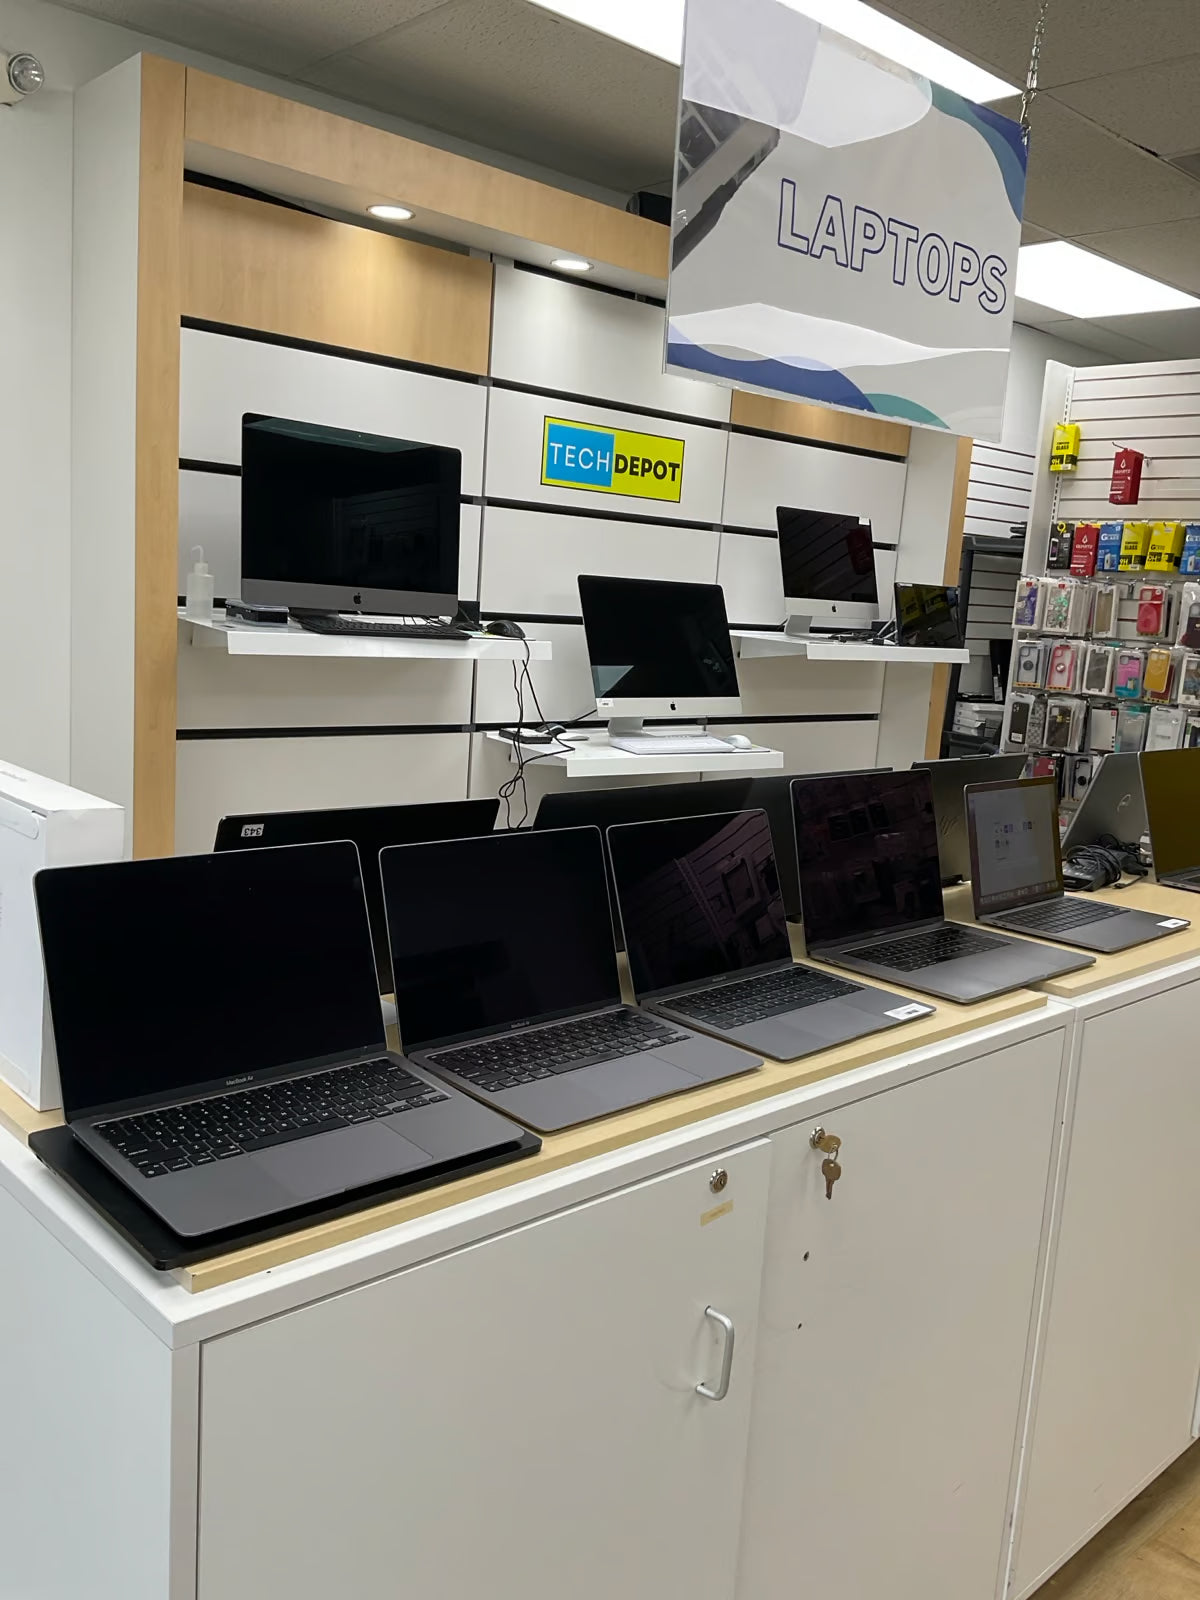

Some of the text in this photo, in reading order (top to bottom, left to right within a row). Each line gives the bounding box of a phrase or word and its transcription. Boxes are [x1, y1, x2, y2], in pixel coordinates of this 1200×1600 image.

[777, 178, 1008, 314] LAPTOPS
[549, 442, 681, 482] TECH DEPOT
[243, 827, 262, 836] 343
